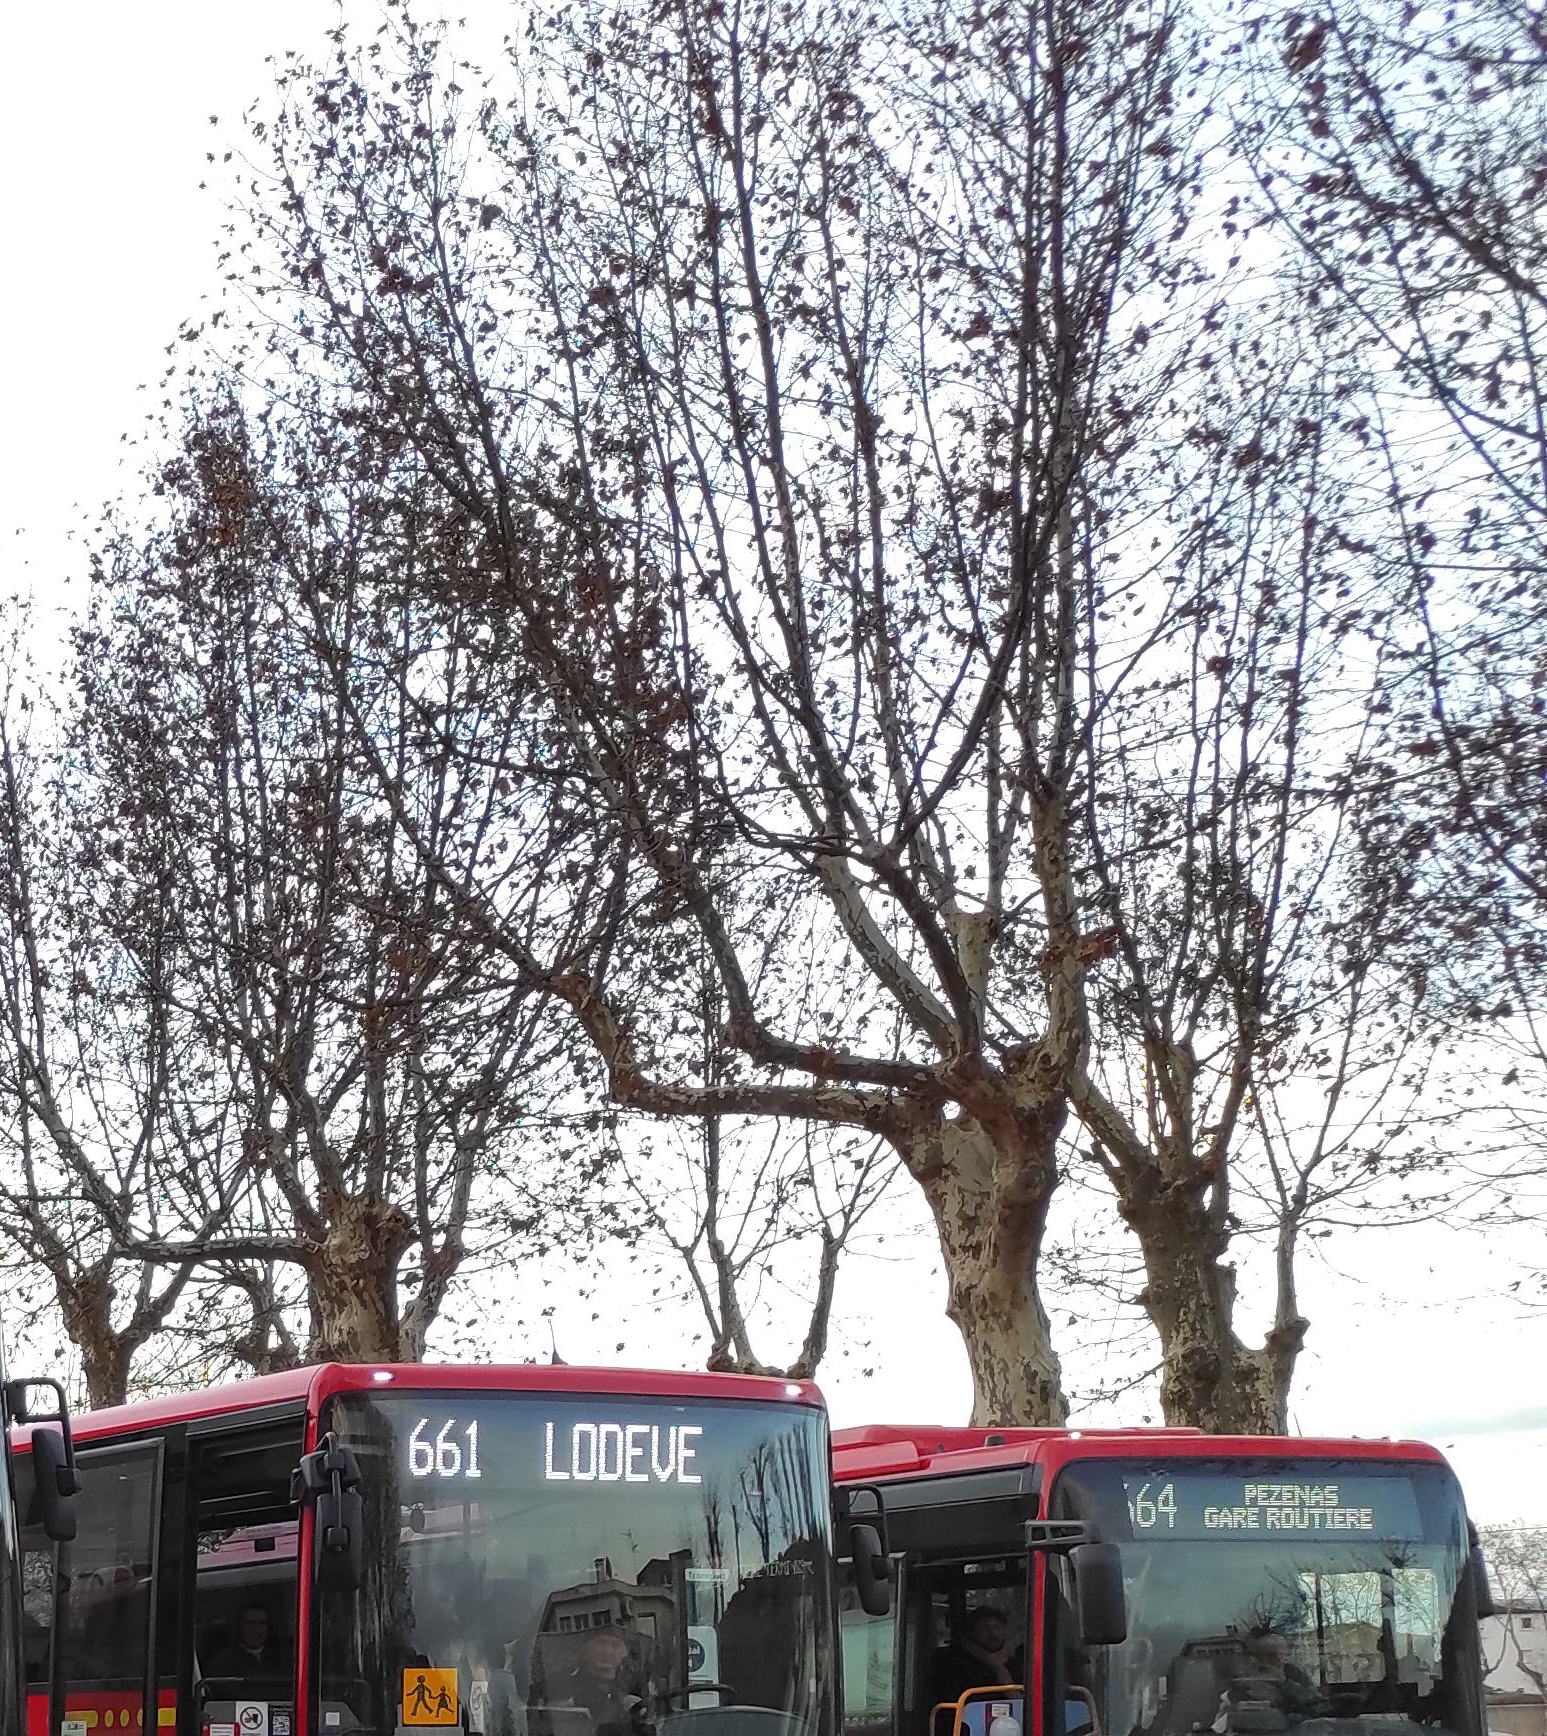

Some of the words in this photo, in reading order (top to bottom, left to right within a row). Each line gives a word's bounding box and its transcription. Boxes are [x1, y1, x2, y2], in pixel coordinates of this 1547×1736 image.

[409, 1418, 483, 1478] 661
[545, 1422, 703, 1482] LODEVE
[1244, 1485, 1339, 1506] PEZENAS
[1204, 1507, 1260, 1530] GARE
[1266, 1507, 1373, 1530] ROUTIERE
